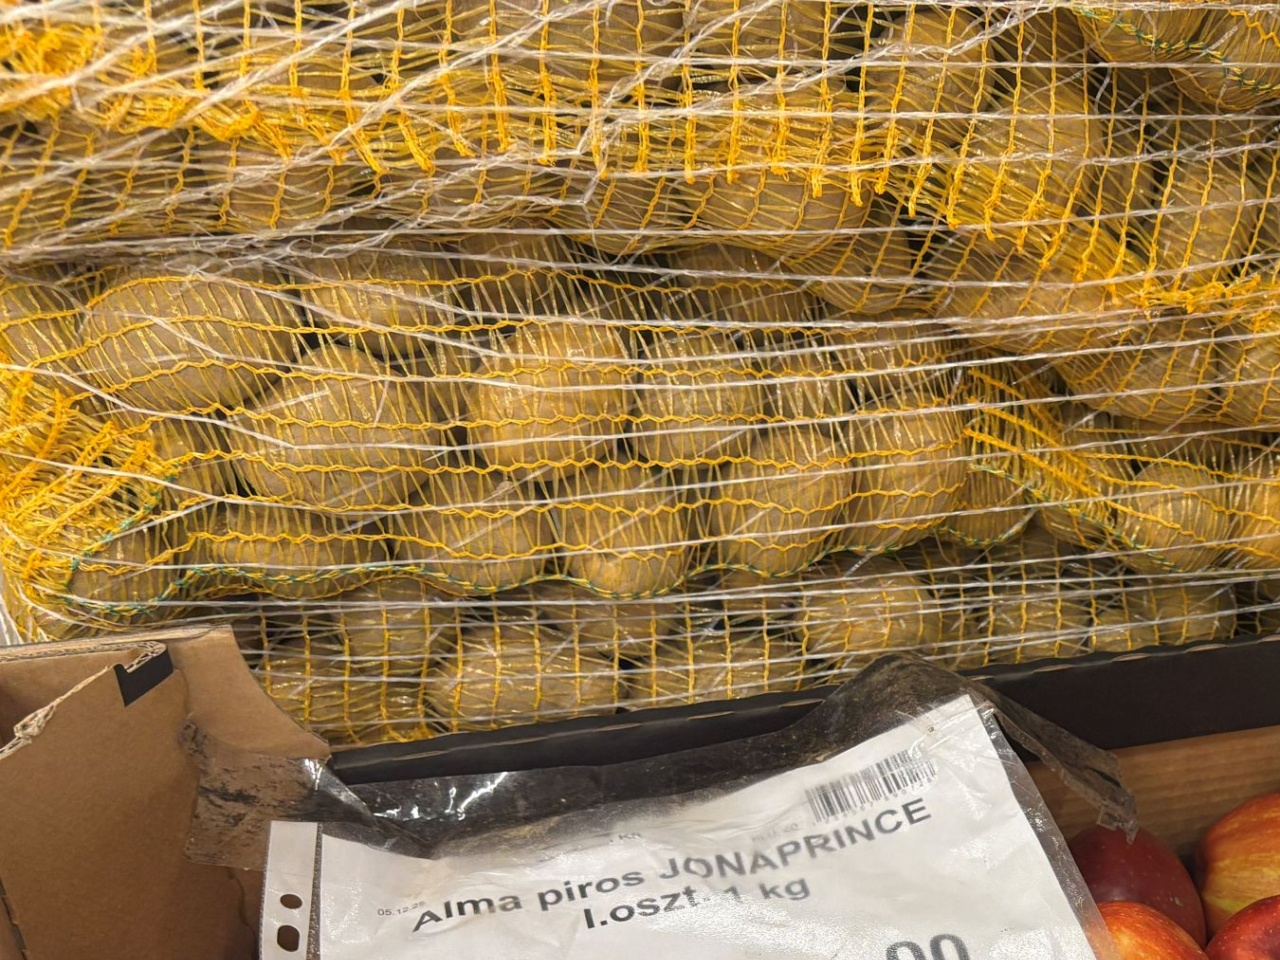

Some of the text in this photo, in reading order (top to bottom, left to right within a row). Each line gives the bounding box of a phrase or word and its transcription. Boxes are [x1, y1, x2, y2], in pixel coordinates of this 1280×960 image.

[412, 894, 522, 933] Alma
[537, 870, 646, 912] piros
[658, 797, 932, 880] JONAPRINCE
[722, 885, 742, 903] 1
[758, 877, 811, 901] kg
